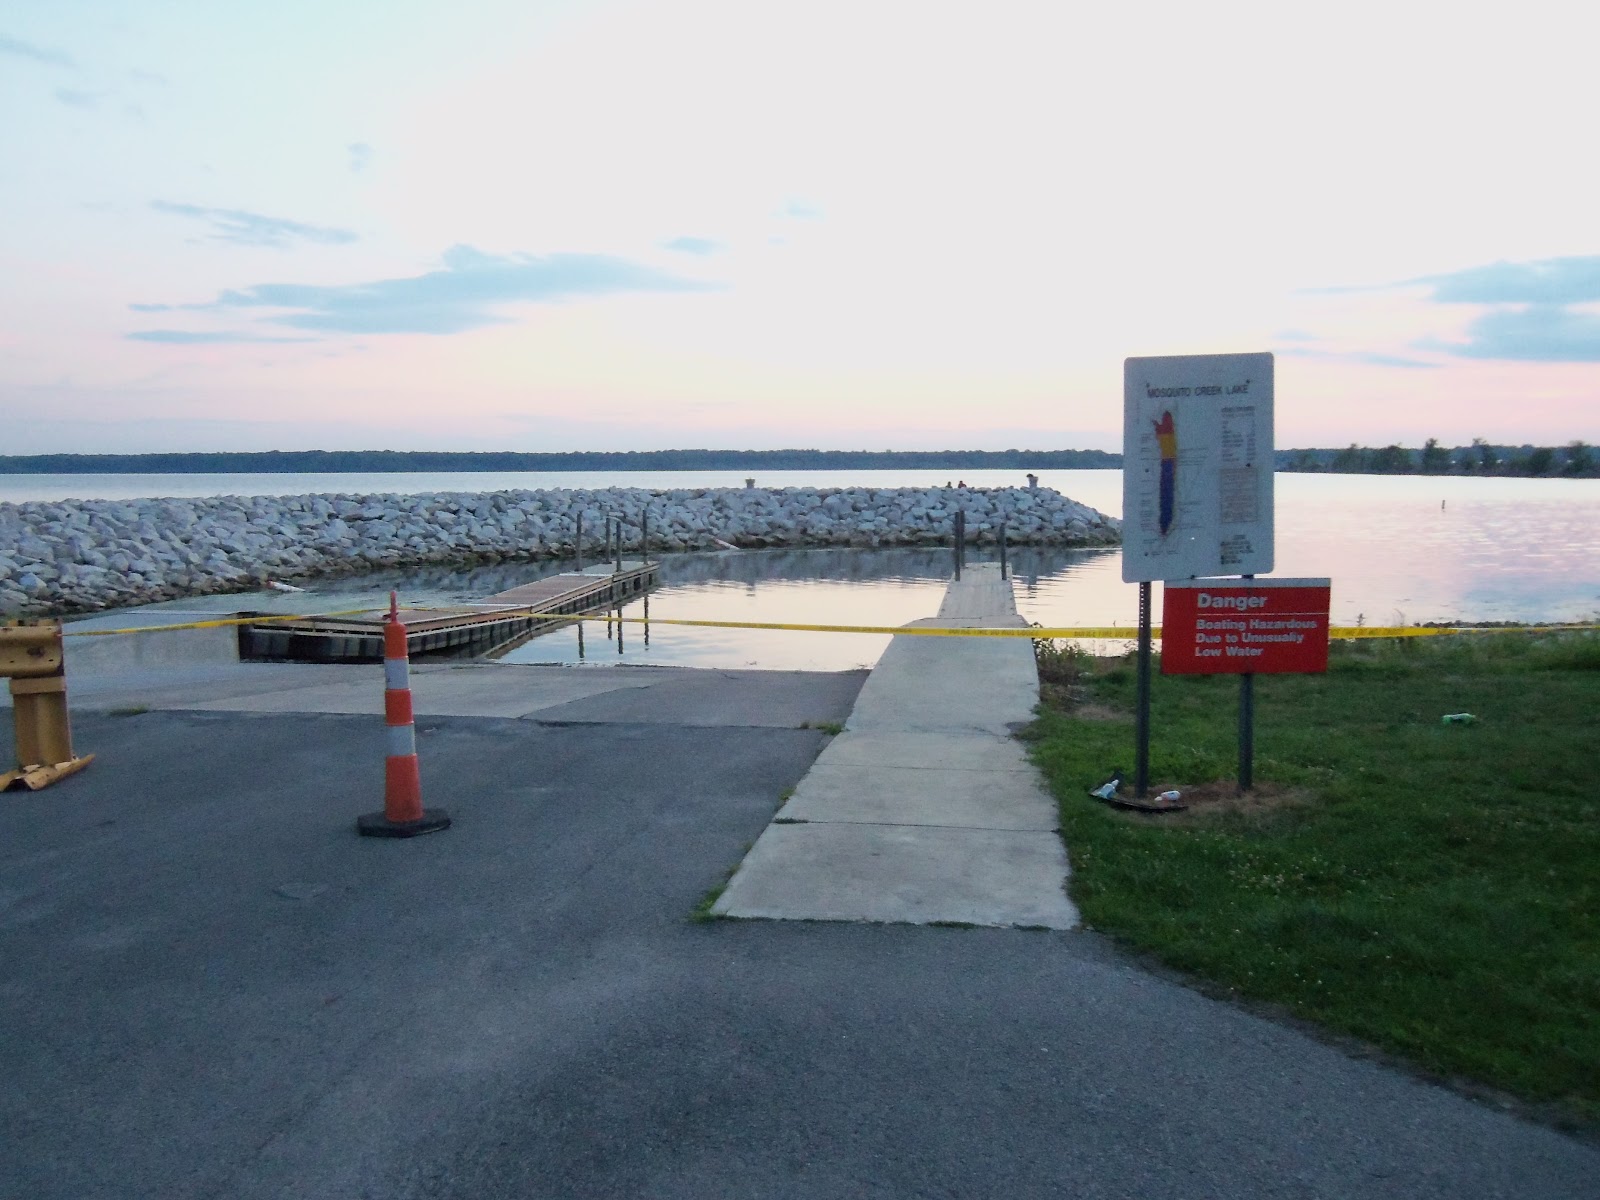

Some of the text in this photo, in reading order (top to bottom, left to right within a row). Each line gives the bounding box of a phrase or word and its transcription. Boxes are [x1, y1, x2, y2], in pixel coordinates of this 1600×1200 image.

[1147, 384, 1249, 398] MOSQUITO CREEK LAKE
[1197, 593, 1268, 610] Danger
[1196, 619, 1317, 630] Boating Hazardous
[1195, 632, 1304, 643] Due to Unusually
[1195, 646, 1264, 656] Low Water
